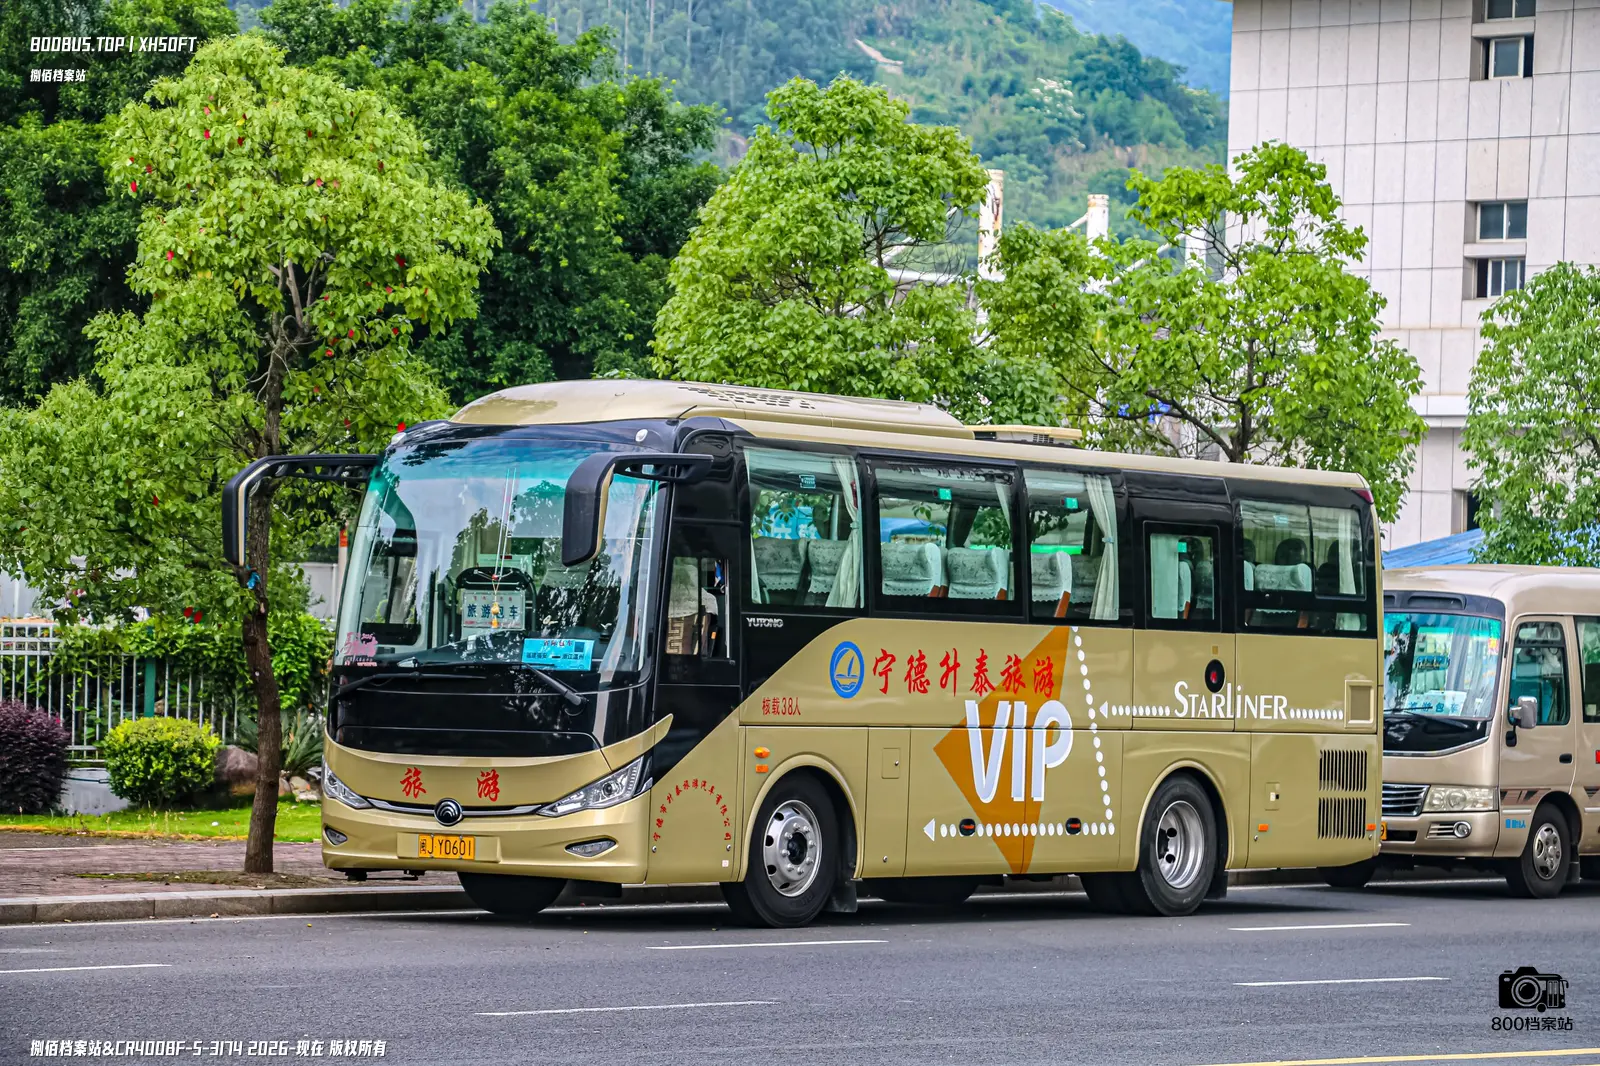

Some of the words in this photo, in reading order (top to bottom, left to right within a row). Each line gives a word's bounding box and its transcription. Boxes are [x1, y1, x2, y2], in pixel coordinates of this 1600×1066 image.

[746, 617, 784, 628] YUTONG
[872, 648, 1055, 699] 宁德升泰旅游
[761, 696, 802, 717] 核载38人
[965, 700, 1074, 804] VIP
